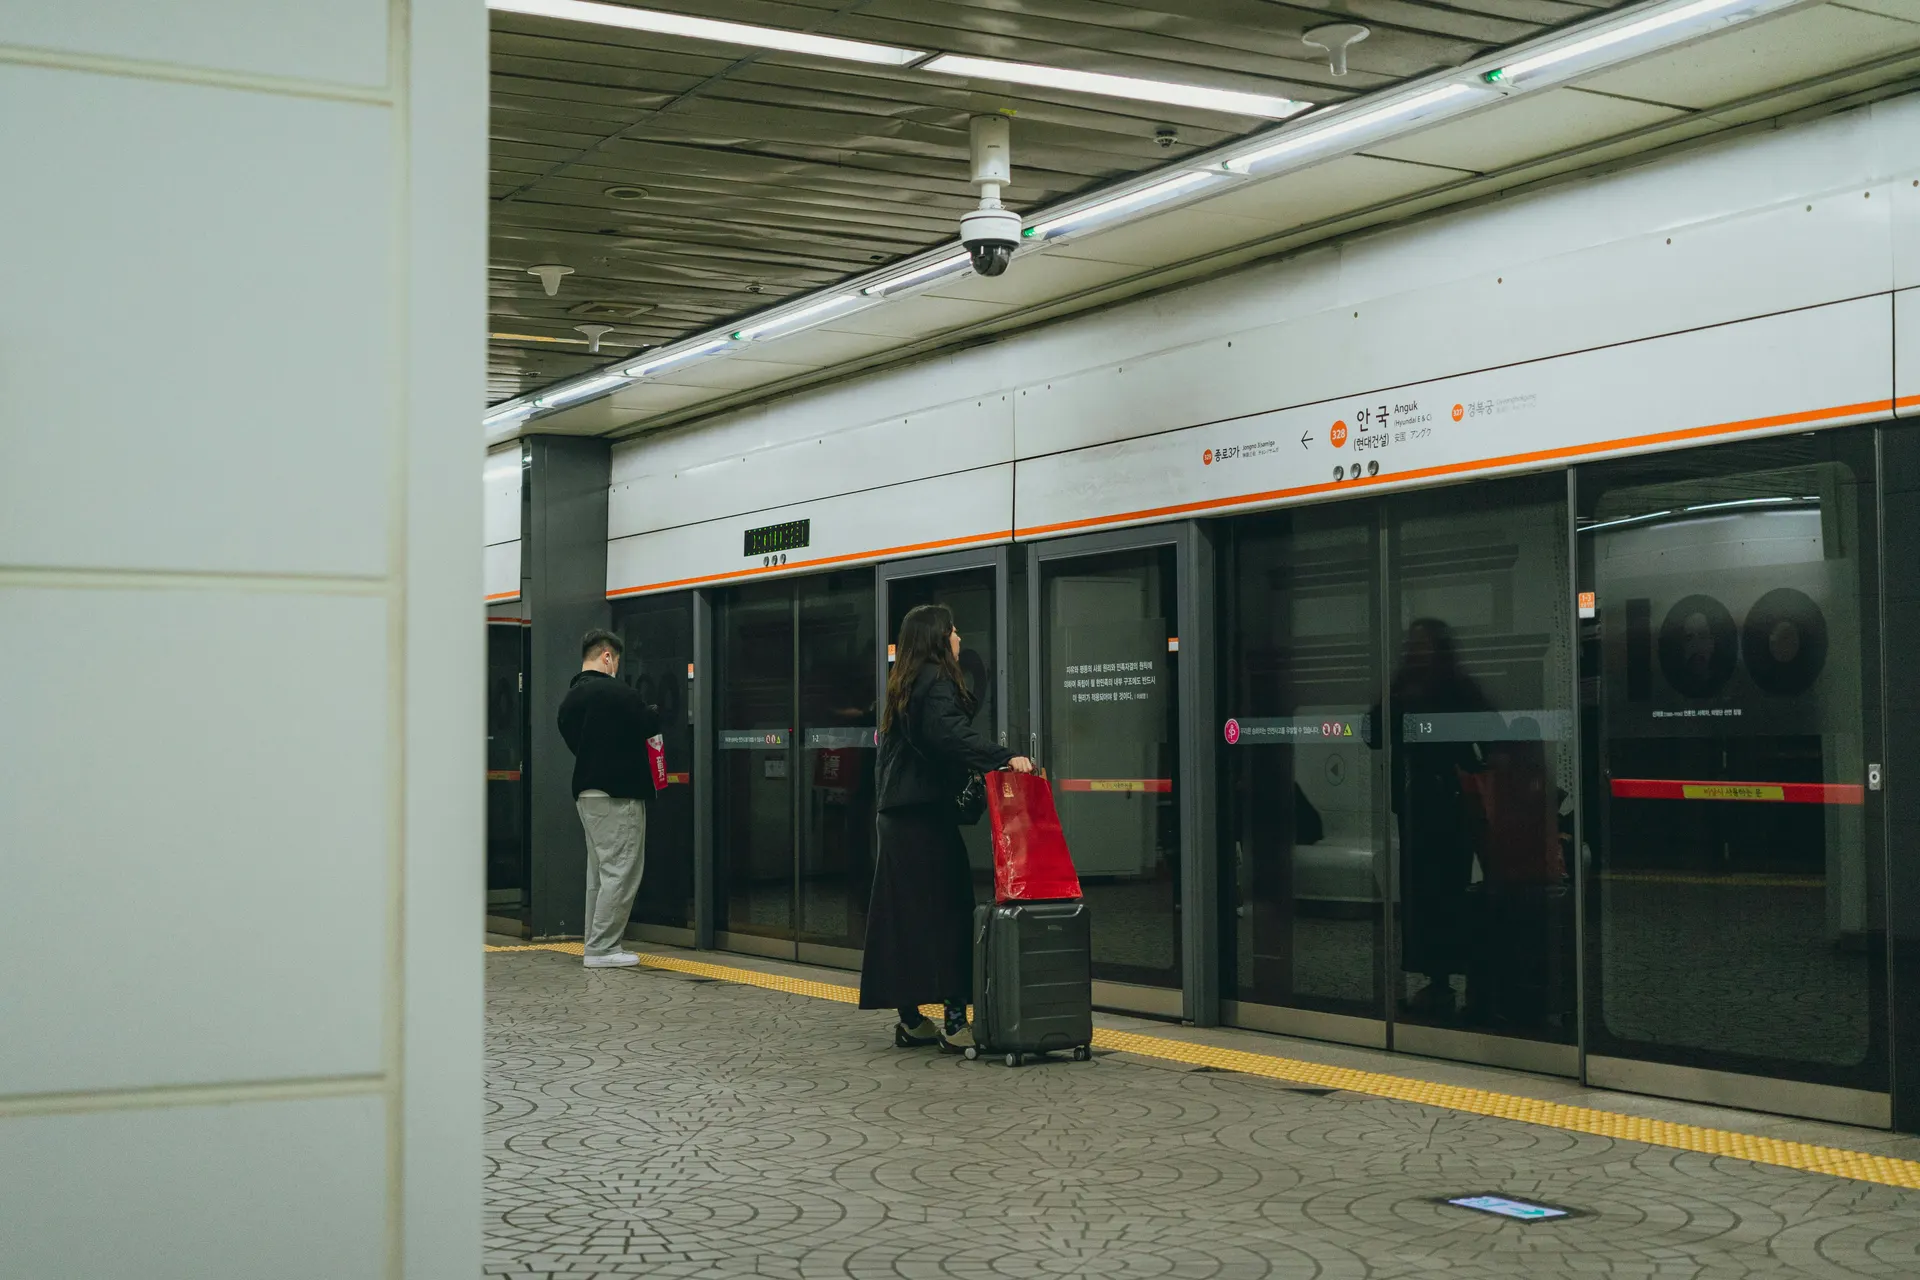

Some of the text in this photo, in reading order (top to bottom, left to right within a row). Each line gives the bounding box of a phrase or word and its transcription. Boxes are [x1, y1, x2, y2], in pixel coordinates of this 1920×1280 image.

[1393, 400, 1418, 414] Anguk
[1452, 408, 1463, 417] 327
[1467, 399, 1494, 418] 경복궁
[1332, 428, 1346, 440] 328
[1353, 433, 1390, 451] (현대건설)
[1214, 445, 1241, 463] 종로3가
[1581, 594, 1592, 602] 1-3
[1113, 677, 1123, 686] 내부
[1123, 676, 1141, 686] 구조에도
[1142, 676, 1156, 685] 반드시
[1119, 691, 1134, 701] 것이다.
[1419, 722, 1432, 733] 1-3
[812, 734, 820, 743] 1-2
[1703, 786, 1762, 798] 비상시 사용하는 문
